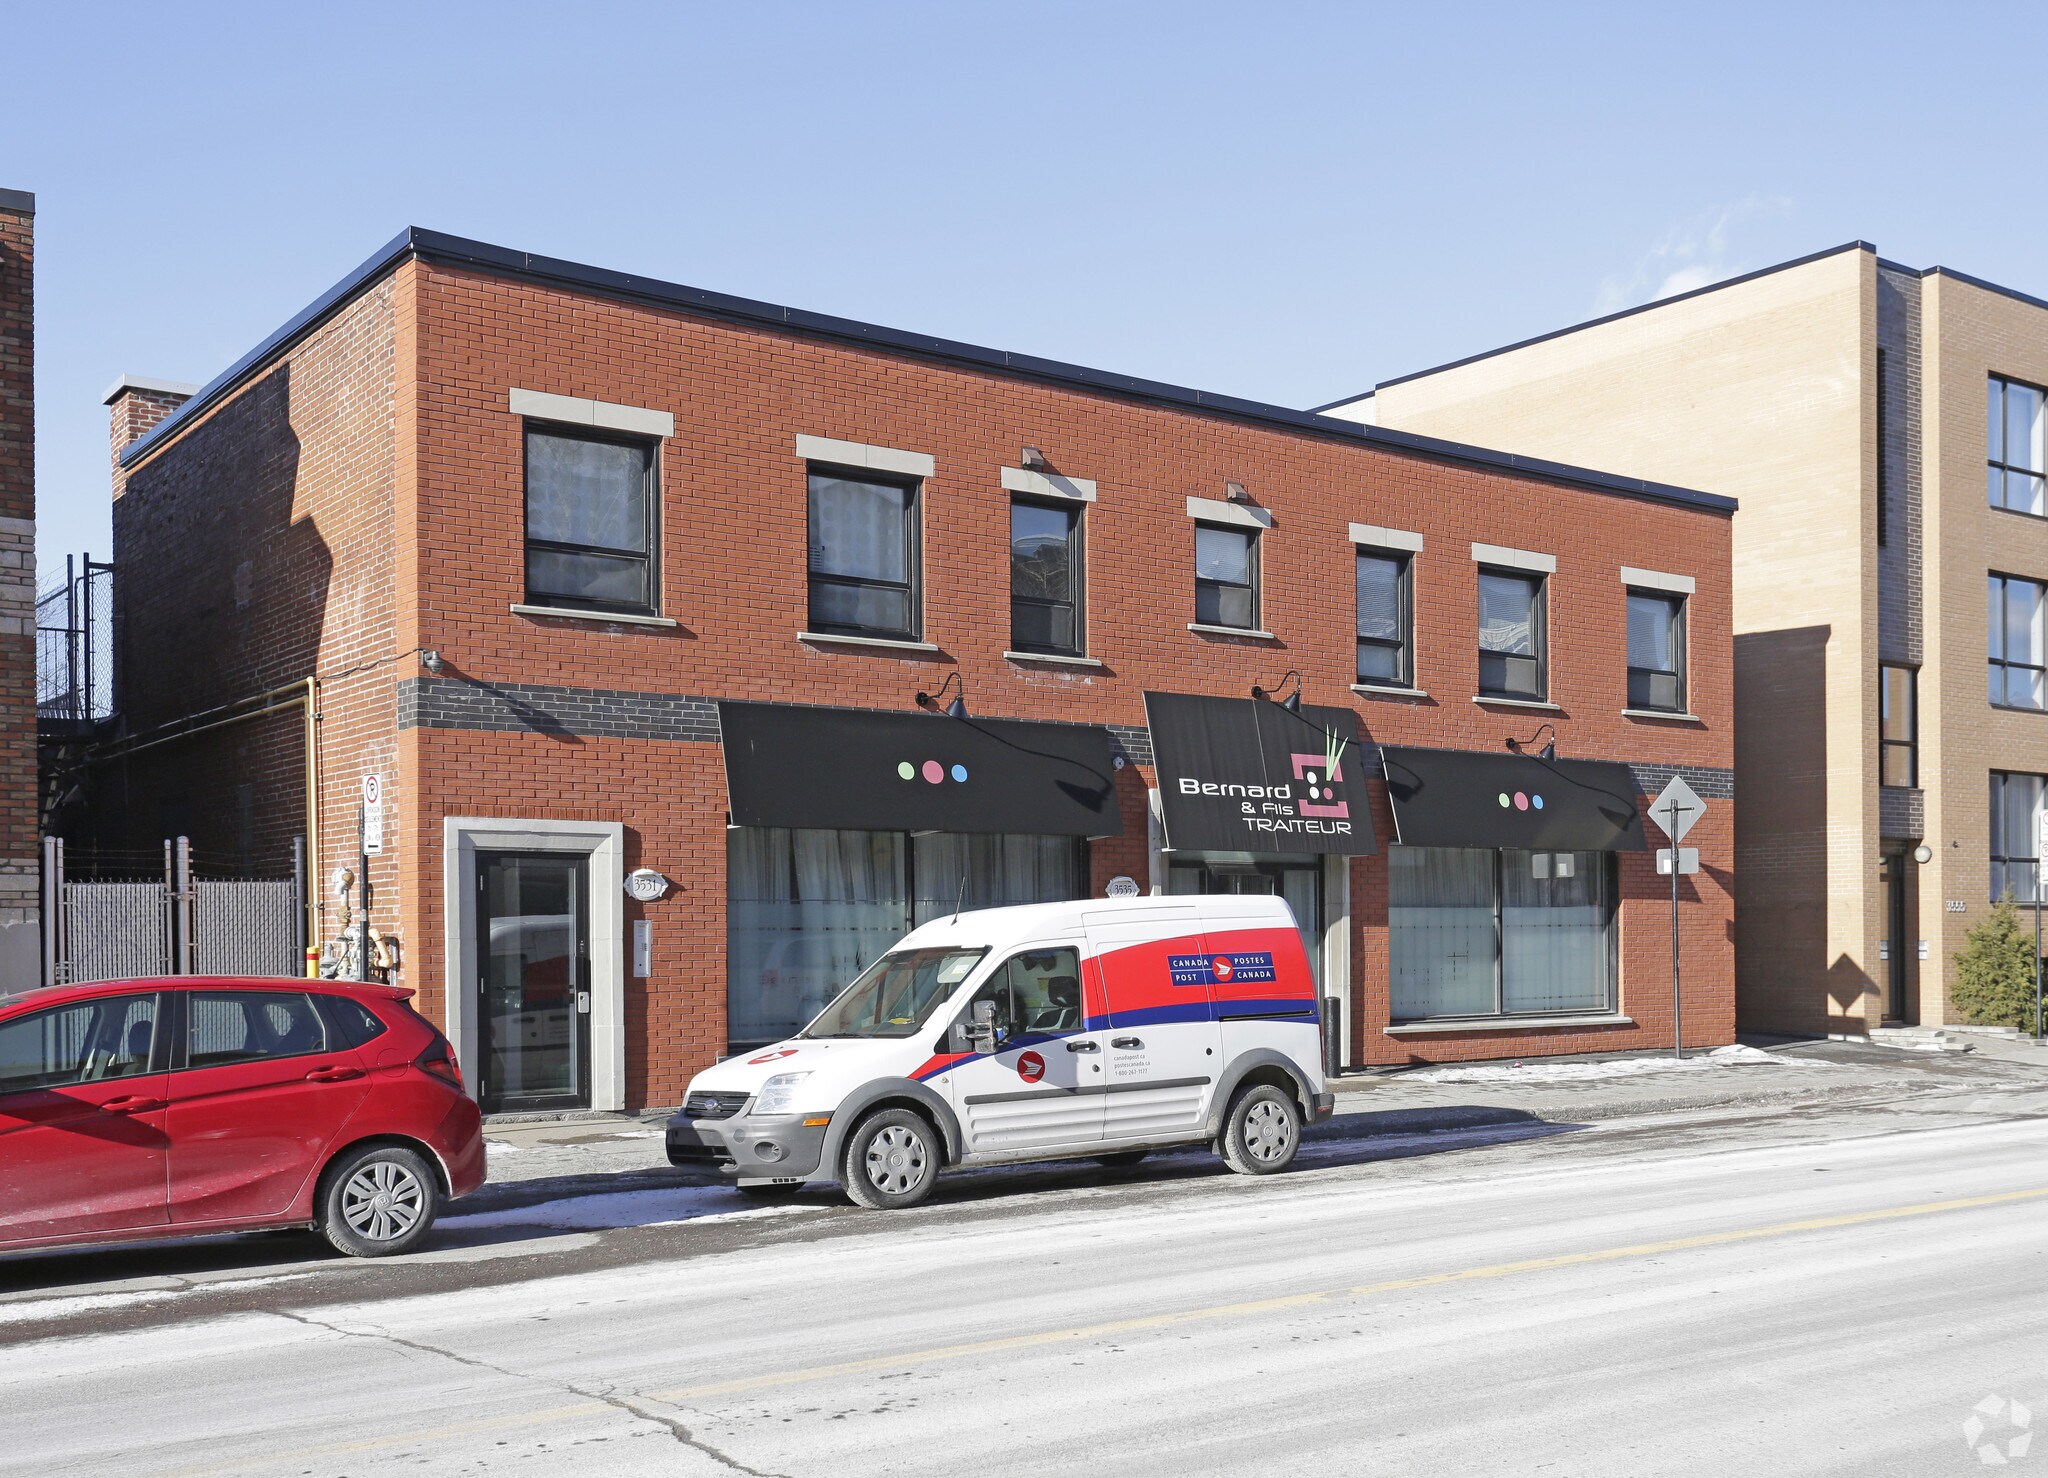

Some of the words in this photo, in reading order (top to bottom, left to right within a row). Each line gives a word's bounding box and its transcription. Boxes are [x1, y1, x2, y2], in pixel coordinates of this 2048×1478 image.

[1178, 778, 1291, 799] Bernard
[1241, 801, 1256, 814] &
[1262, 802, 1294, 816] Fils
[1242, 817, 1352, 835] TRAITEUR
[634, 879, 656, 891] 3531
[1114, 884, 1133, 895] 3535
[1173, 958, 1209, 967] CANADA
[1234, 956, 1265, 965] POSTES
[1175, 973, 1197, 981] POST
[1237, 970, 1272, 979] CANADA
